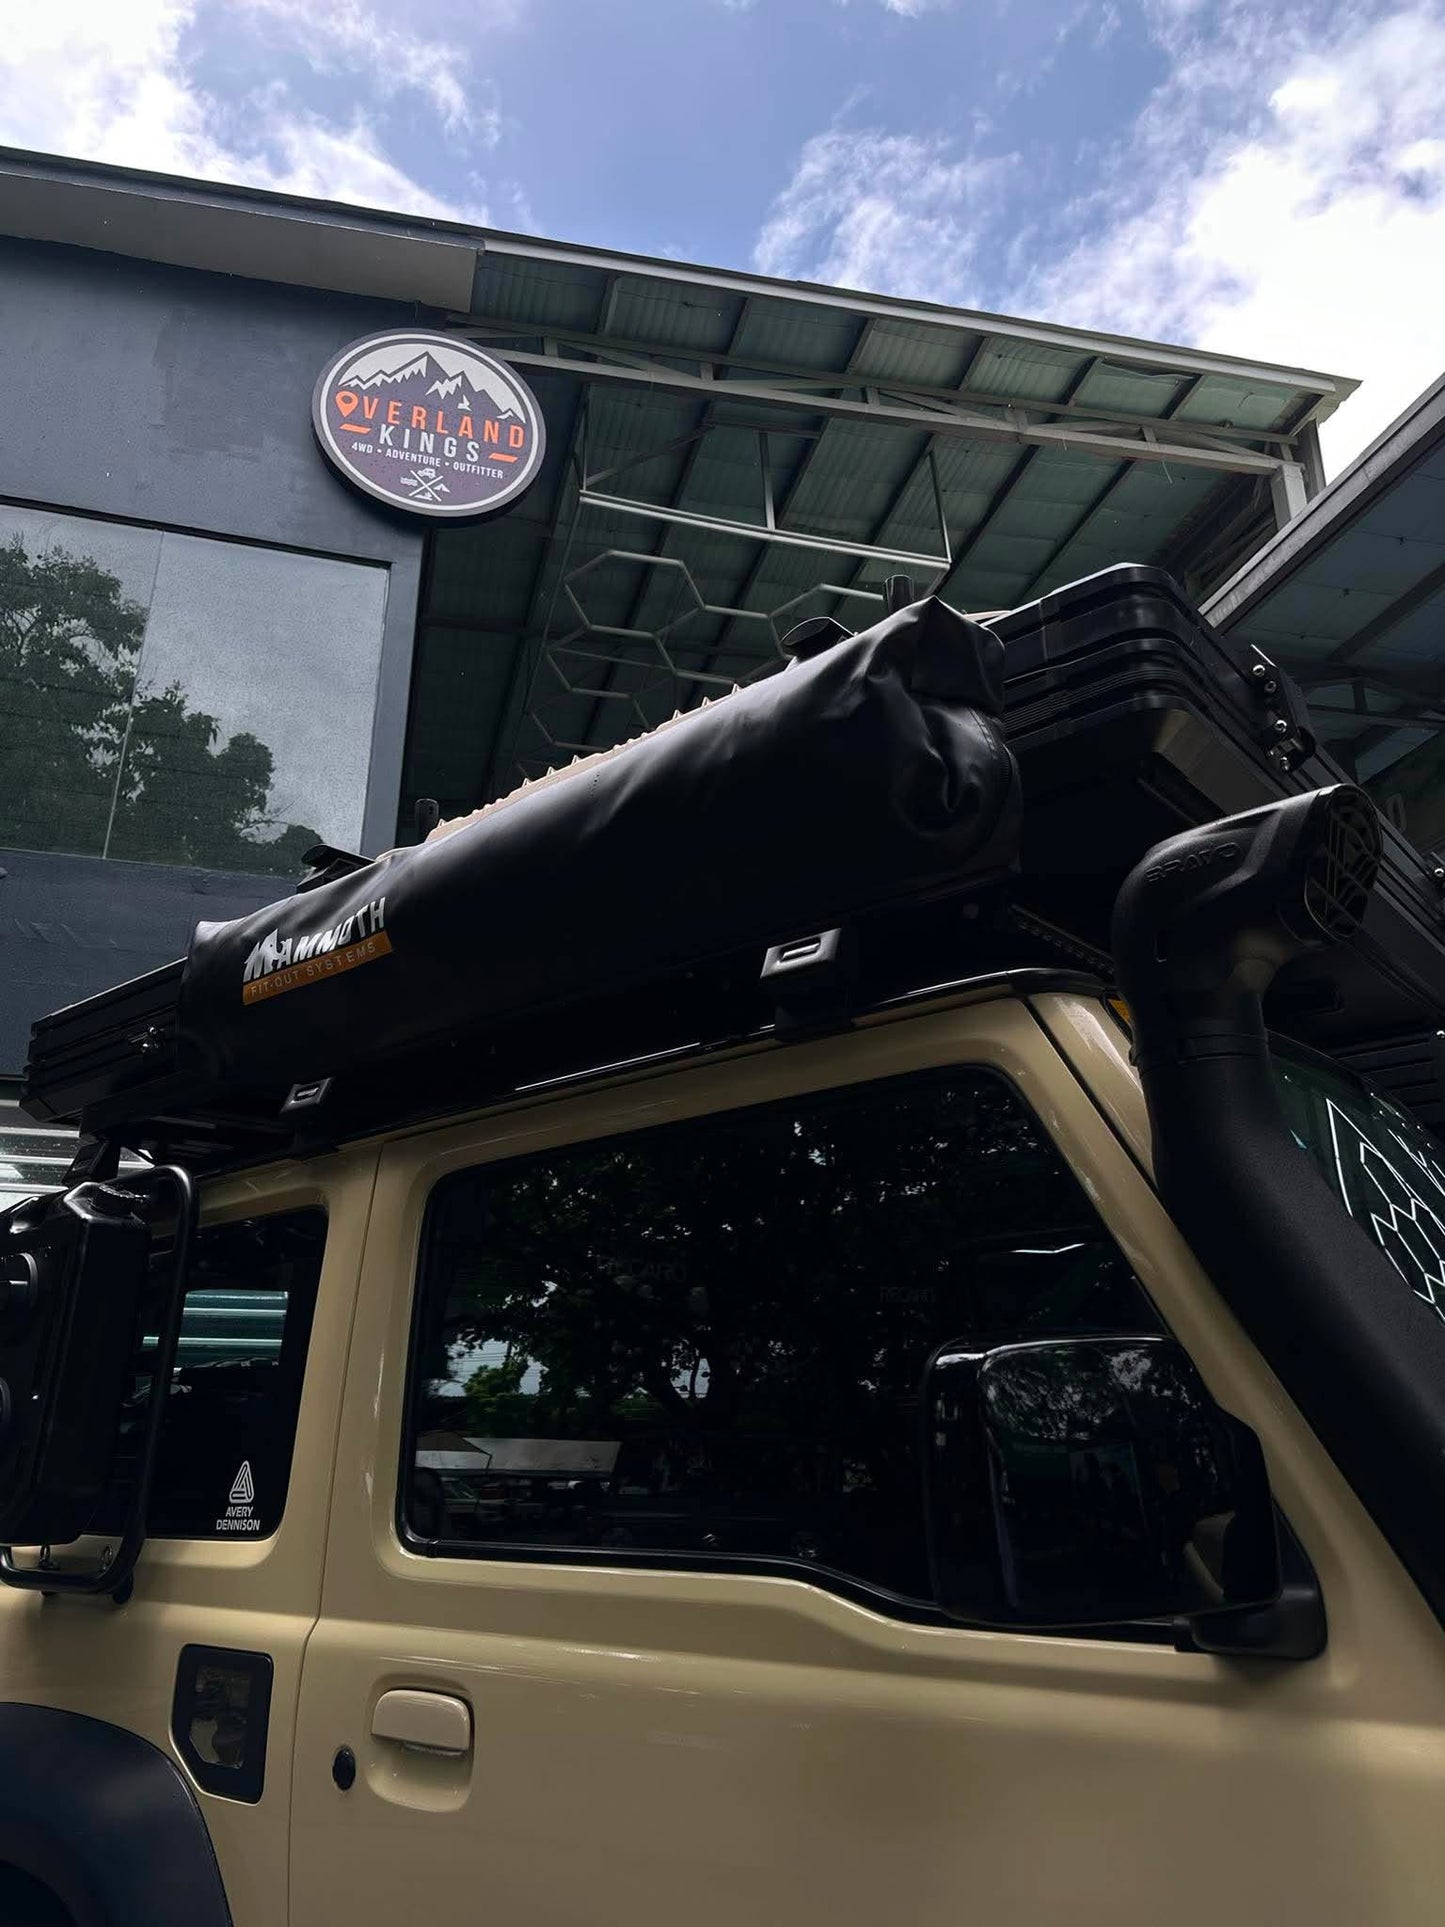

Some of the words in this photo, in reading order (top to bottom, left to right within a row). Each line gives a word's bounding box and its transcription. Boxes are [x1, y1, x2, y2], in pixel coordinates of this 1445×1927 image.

[351, 441, 374, 454] 4WD
[385, 448, 442, 467] ADVENTURE
[453, 461, 504, 479] OUTFITTER
[379, 423, 481, 462] KINGS
[242, 897, 386, 983] MAMMOTH
[306, 941, 376, 977] SYSTEMS
[216, 1519, 261, 1531] DENNISON
[225, 1506, 254, 1517] AVERY
